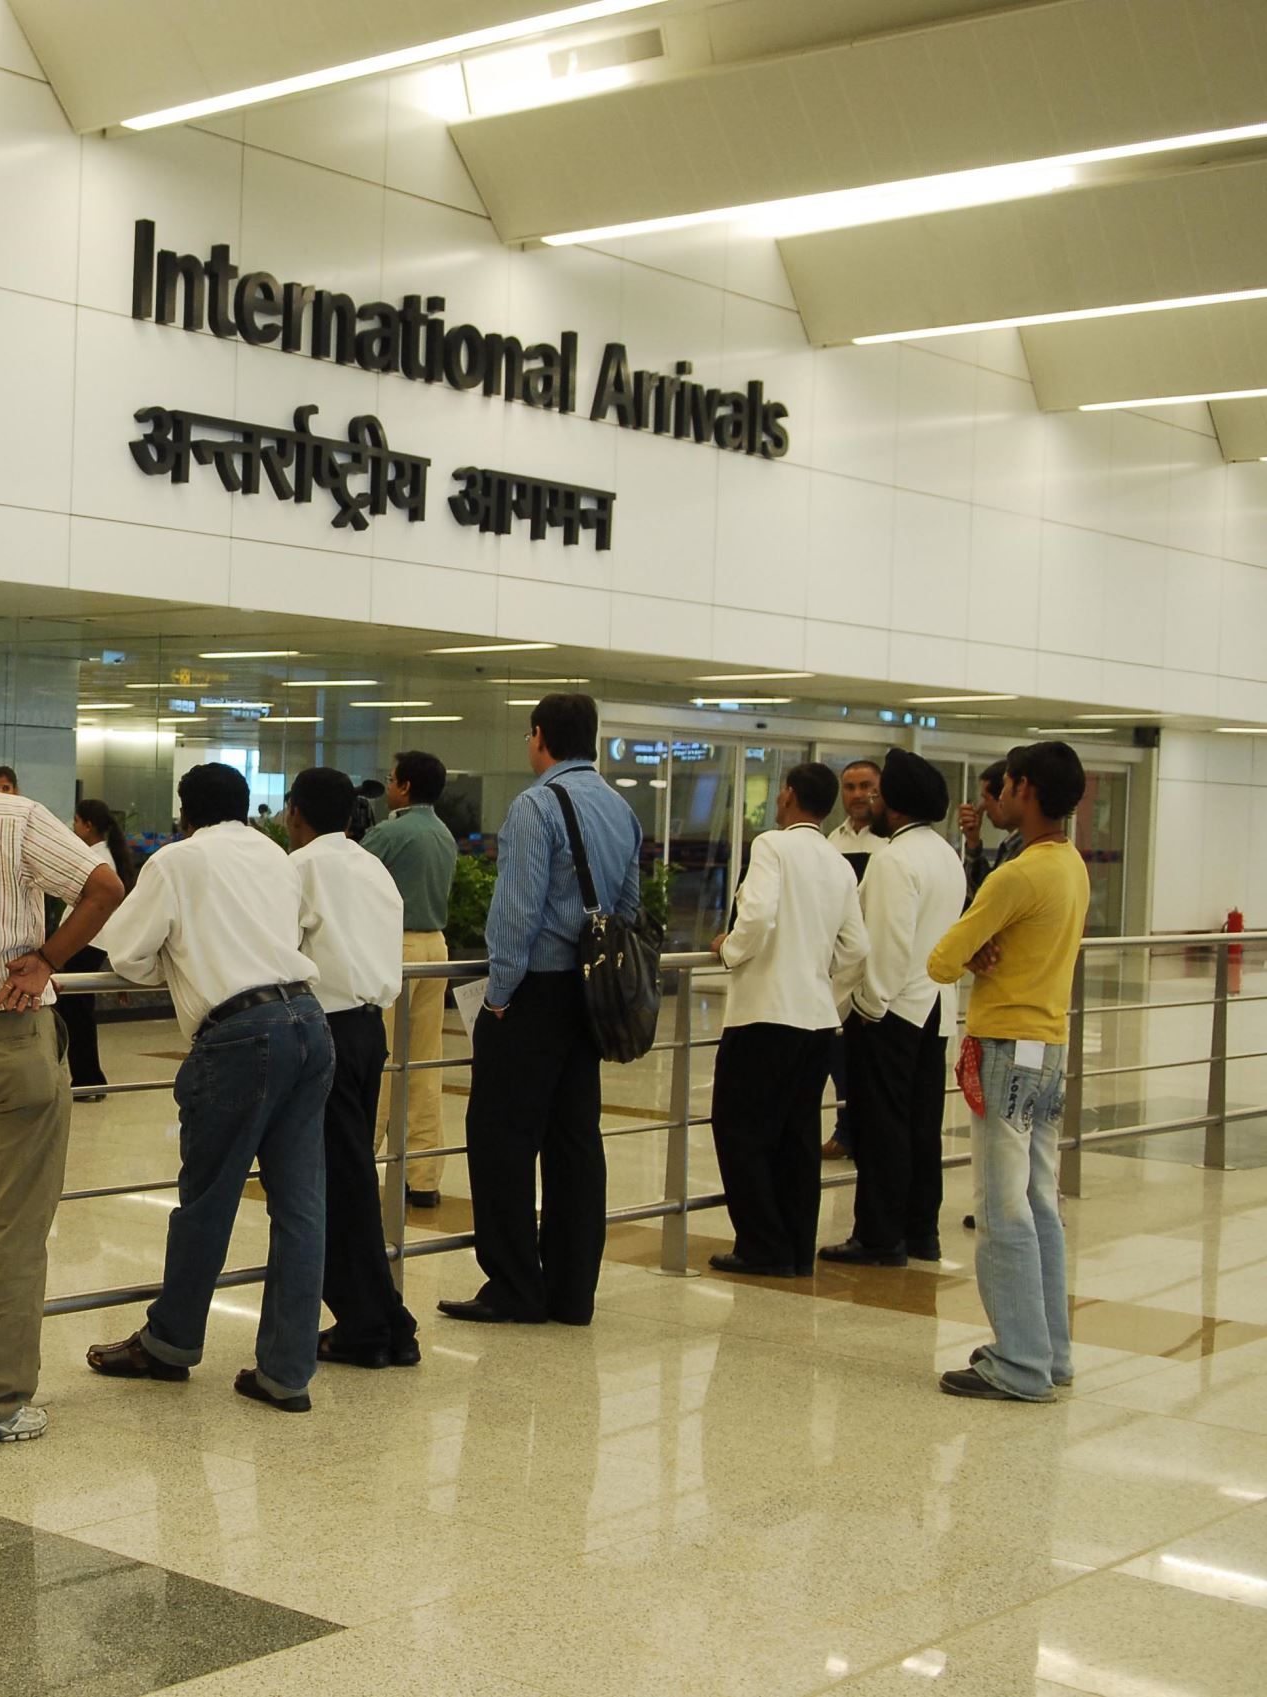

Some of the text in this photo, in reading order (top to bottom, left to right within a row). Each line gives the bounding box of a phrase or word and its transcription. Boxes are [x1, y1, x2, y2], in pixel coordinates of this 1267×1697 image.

[131, 218, 789, 459] International Arrivals
[128, 403, 617, 551] अन्तर्राष्ट्रीय आगमन
